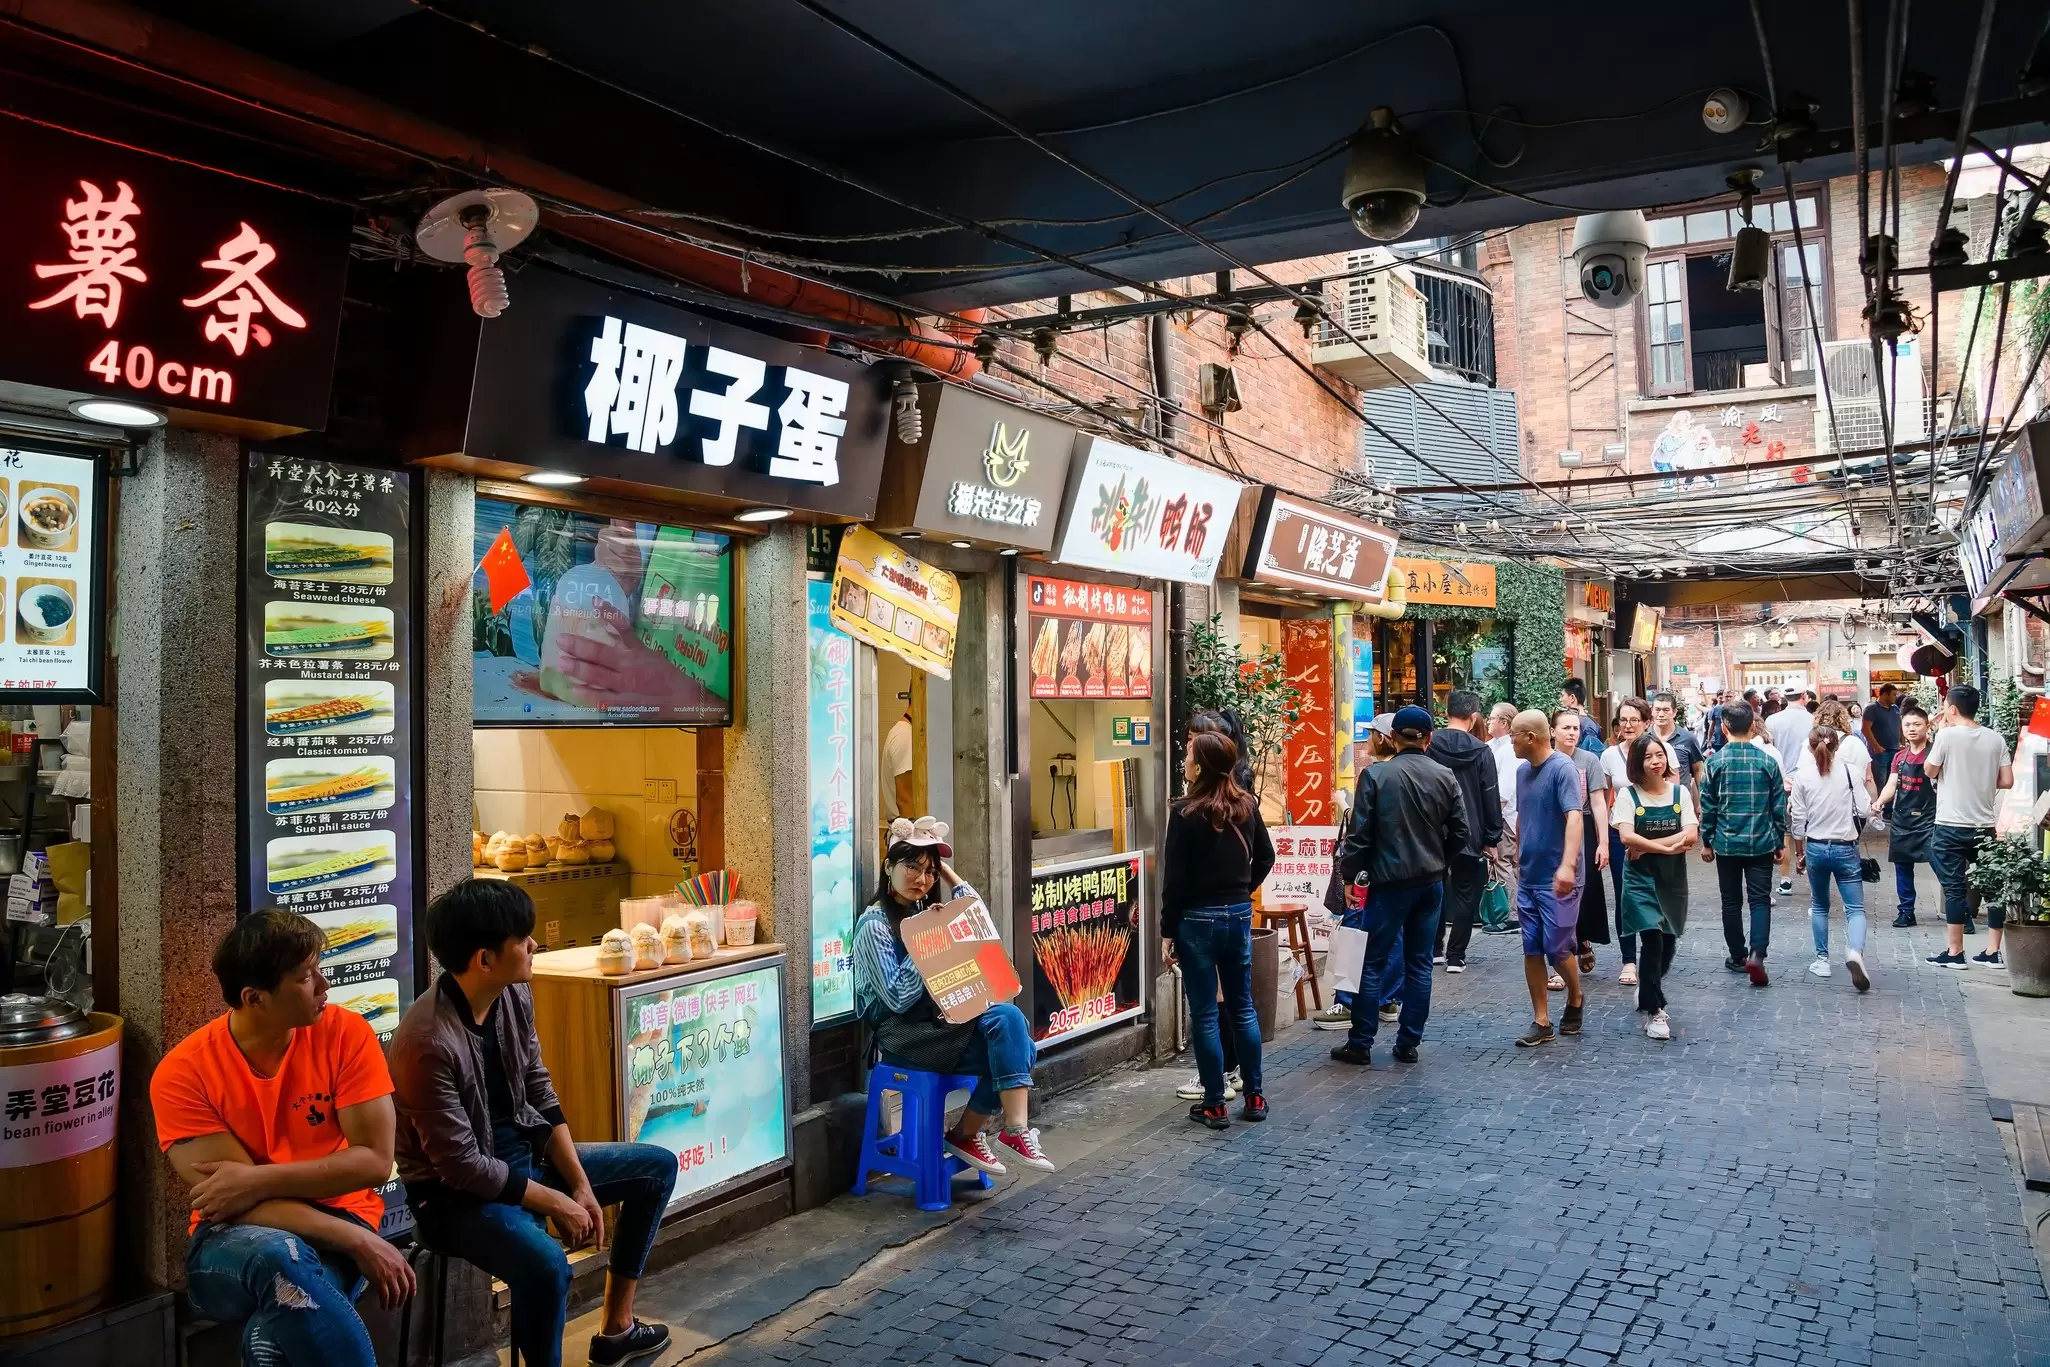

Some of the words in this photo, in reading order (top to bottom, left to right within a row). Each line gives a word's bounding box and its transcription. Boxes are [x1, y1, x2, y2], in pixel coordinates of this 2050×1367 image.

[28, 180, 307, 356] 薯条
[89, 341, 233, 403] 40cm
[584, 315, 850, 487] 椰子蛋
[268, 461, 395, 494] 弄堂大个子薯条
[304, 499, 361, 517] 40公分
[811, 526, 832, 554] 15
[273, 579, 330, 593] 海苔芝士
[340, 585, 387, 596] 28元/份
[1406, 570, 1452, 595] 真小屋
[293, 591, 340, 602] Seaweed
[341, 595, 376, 605] cheese
[301, 670, 342, 680] Mustard
[344, 671, 370, 680] salad
[354, 662, 401, 671] 28元/份
[267, 736, 338, 748] 经典番茄味
[348, 735, 394, 746] 28元/份
[827, 639, 849, 831] 椰子下了个蛋
[297, 747, 332, 756] Classic
[332, 746, 368, 755] tomato
[275, 813, 331, 827] 苏菲尔酱
[342, 810, 388, 821] 28元/份
[295, 825, 317, 834] Sue
[318, 823, 339, 834] phil
[341, 821, 371, 831] sauce
[1272, 863, 1334, 876] 进店免费品
[276, 891, 333, 905] 蜂蜜色拉
[343, 883, 390, 897] 28元/份
[289, 901, 326, 914] Honey
[328, 900, 347, 909] the
[348, 896, 377, 907] salad
[321, 967, 334, 977] 甜
[345, 958, 391, 973] 28元/份
[343, 975, 361, 984] and
[363, 970, 385, 980] sour
[642, 1007, 669, 1030] 抖音
[674, 996, 700, 1021] 微博
[705, 989, 730, 1013] 快手
[734, 983, 759, 1003] 网红
[1049, 991, 1115, 1033] 20元/30串
[632, 1019, 752, 1088] 椰子下了个蛋
[4, 1069, 115, 1122] 弄堂豆花
[650, 1079, 705, 1105] 100%纯天然
[4, 1125, 41, 1140] bean
[87, 1112, 96, 1123] in
